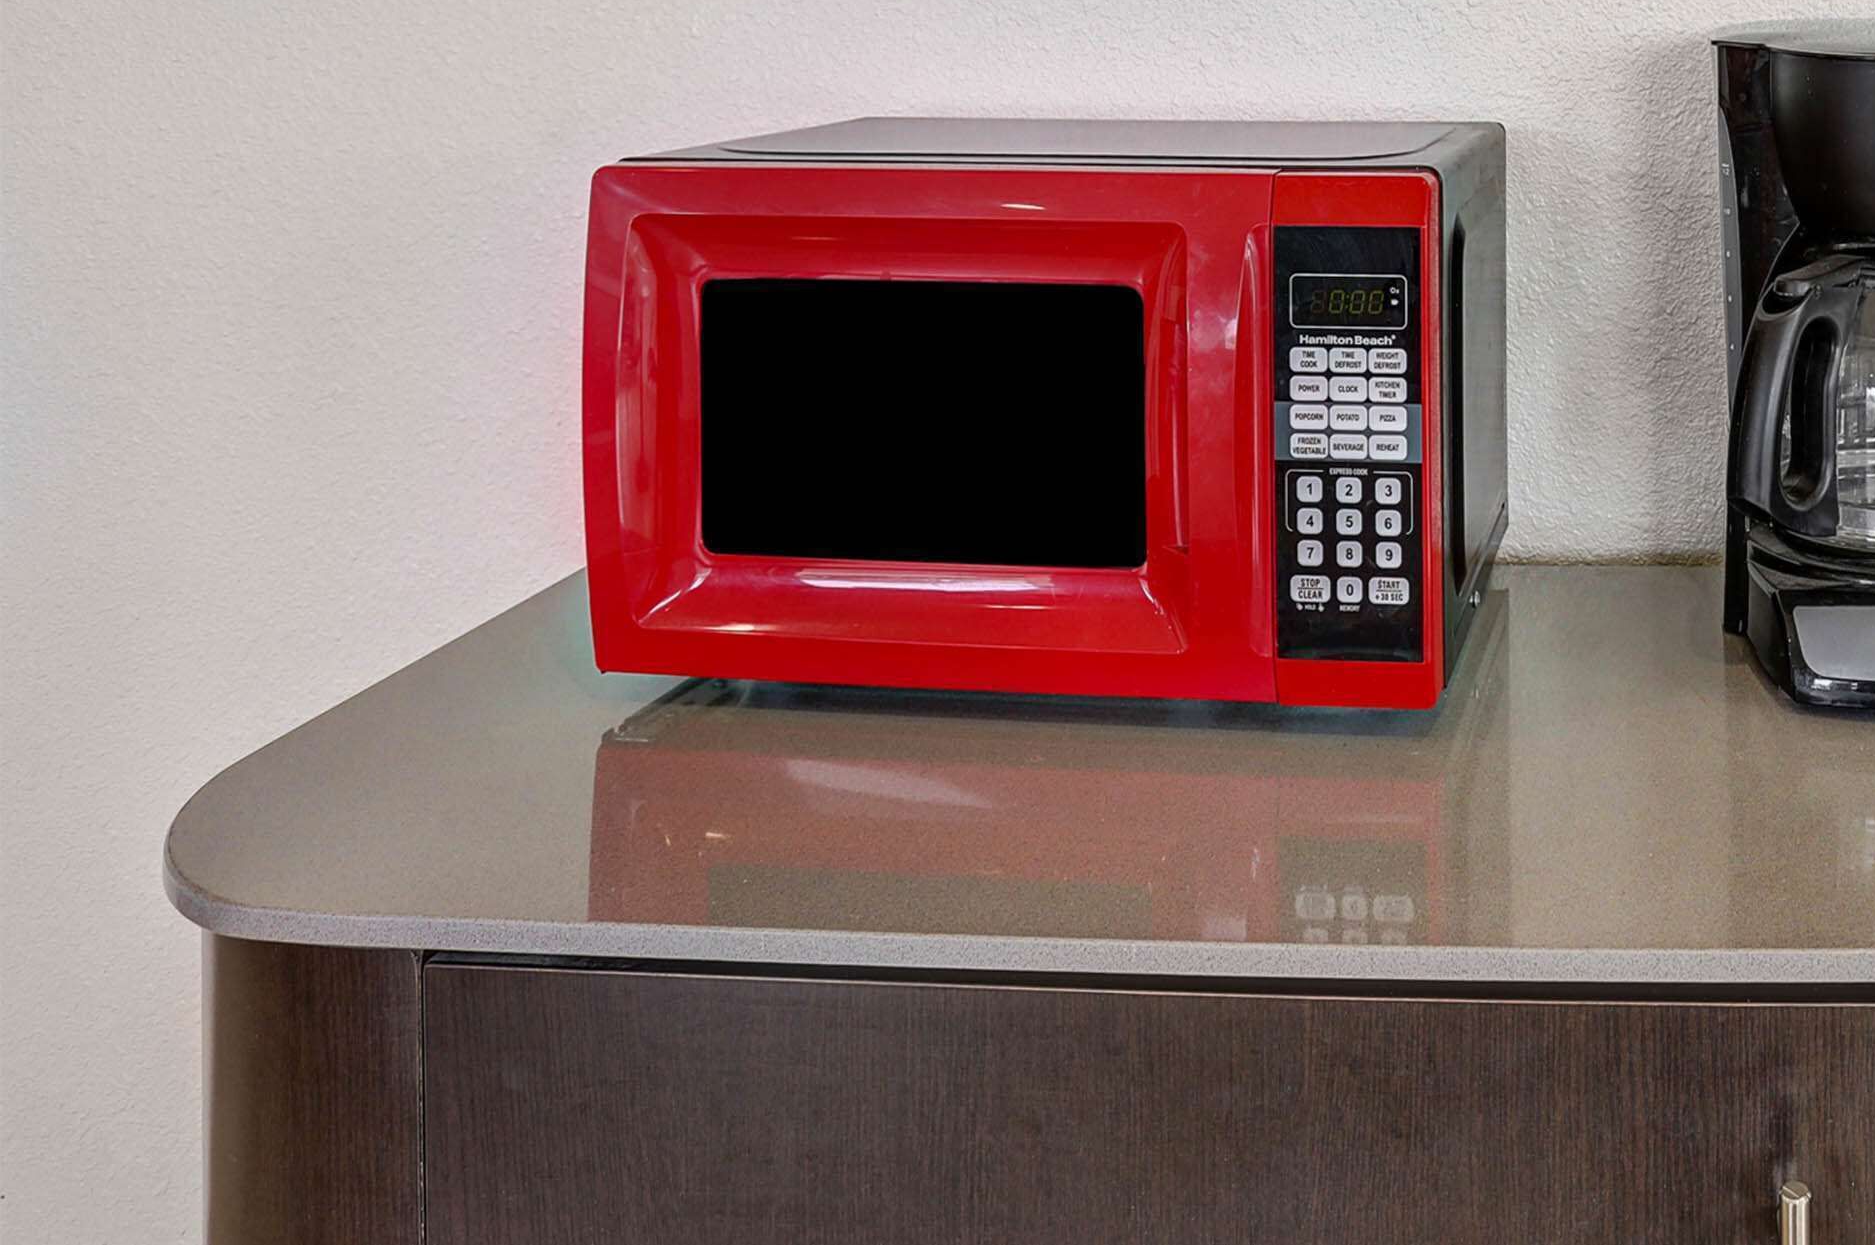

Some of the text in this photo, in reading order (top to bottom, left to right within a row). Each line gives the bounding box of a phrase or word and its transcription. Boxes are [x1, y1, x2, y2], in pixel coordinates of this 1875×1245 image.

[1299, 334, 1393, 346] Hamilton Beach
[1375, 352, 1400, 360] WEIGHT
[1300, 360, 1318, 368] COOK
[1334, 360, 1362, 369] DEFROST
[1374, 361, 1401, 370] DEFROST
[1298, 384, 1320, 392] POWER
[1338, 385, 1359, 393] CLOCK
[1375, 381, 1401, 389] KITCHEN
[1379, 391, 1397, 399] TIMER
[1295, 412, 1324, 421] POPCORN
[1336, 413, 1360, 422] POTATO
[1379, 414, 1397, 423] PIZZA
[1298, 437, 1321, 445] FROZEN
[1293, 446, 1326, 455] VEGETABLE
[1333, 443, 1364, 451] BEVERAGE
[1376, 444, 1400, 452] REHEAT
[1307, 483, 1312, 495] 1
[1345, 484, 1353, 497] 2
[1384, 485, 1393, 497] 3
[1306, 515, 1314, 527] 4
[1345, 516, 1354, 528] 5
[1384, 517, 1393, 530] 6
[1307, 547, 1314, 559] 7
[1345, 548, 1354, 560] 8
[1385, 549, 1393, 561] 9
[1300, 579, 1320, 587] STOP
[1378, 581, 1401, 589] START
[1298, 590, 1323, 599] CLEAR
[1346, 584, 1354, 596] 0
[1391, 592, 1403, 601] SEC
